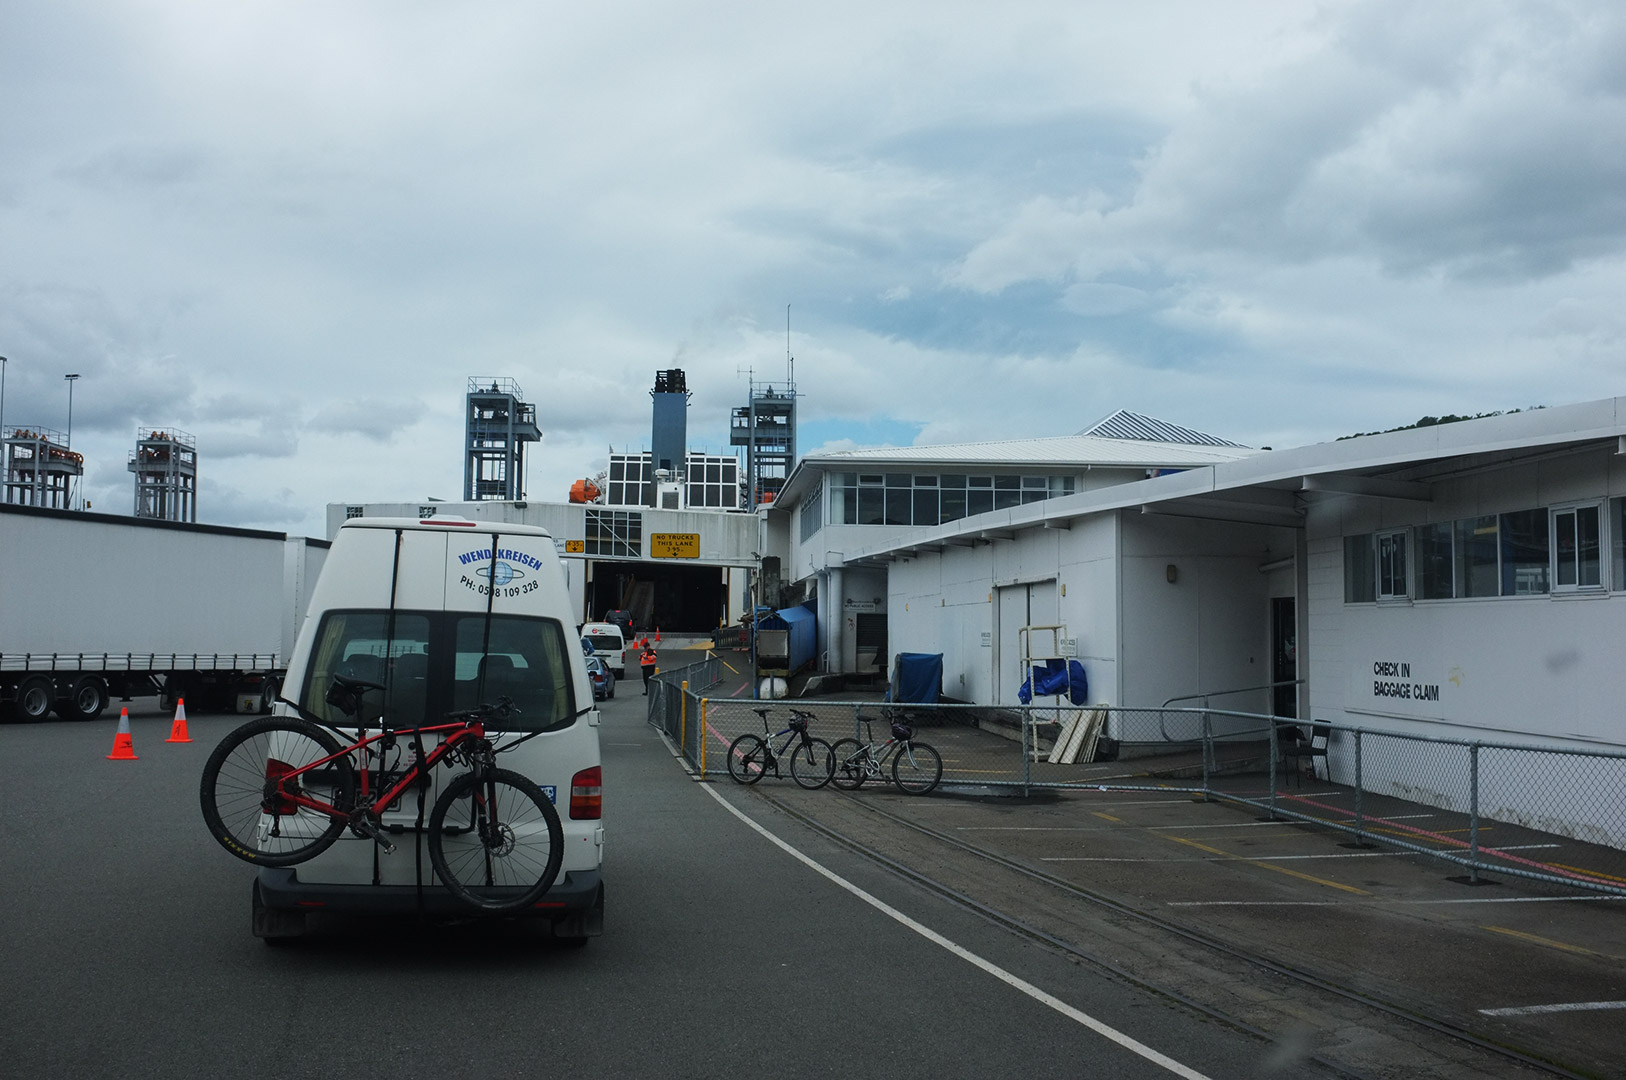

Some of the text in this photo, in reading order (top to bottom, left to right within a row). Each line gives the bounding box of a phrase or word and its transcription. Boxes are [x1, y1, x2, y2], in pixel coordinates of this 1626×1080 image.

[458, 548, 543, 571] WENDKREISEN
[460, 575, 539, 598] PH: 058 109 328
[1373, 661, 1411, 678] CHECK IN
[1374, 680, 1440, 701] BAGGAGE CLAIM
